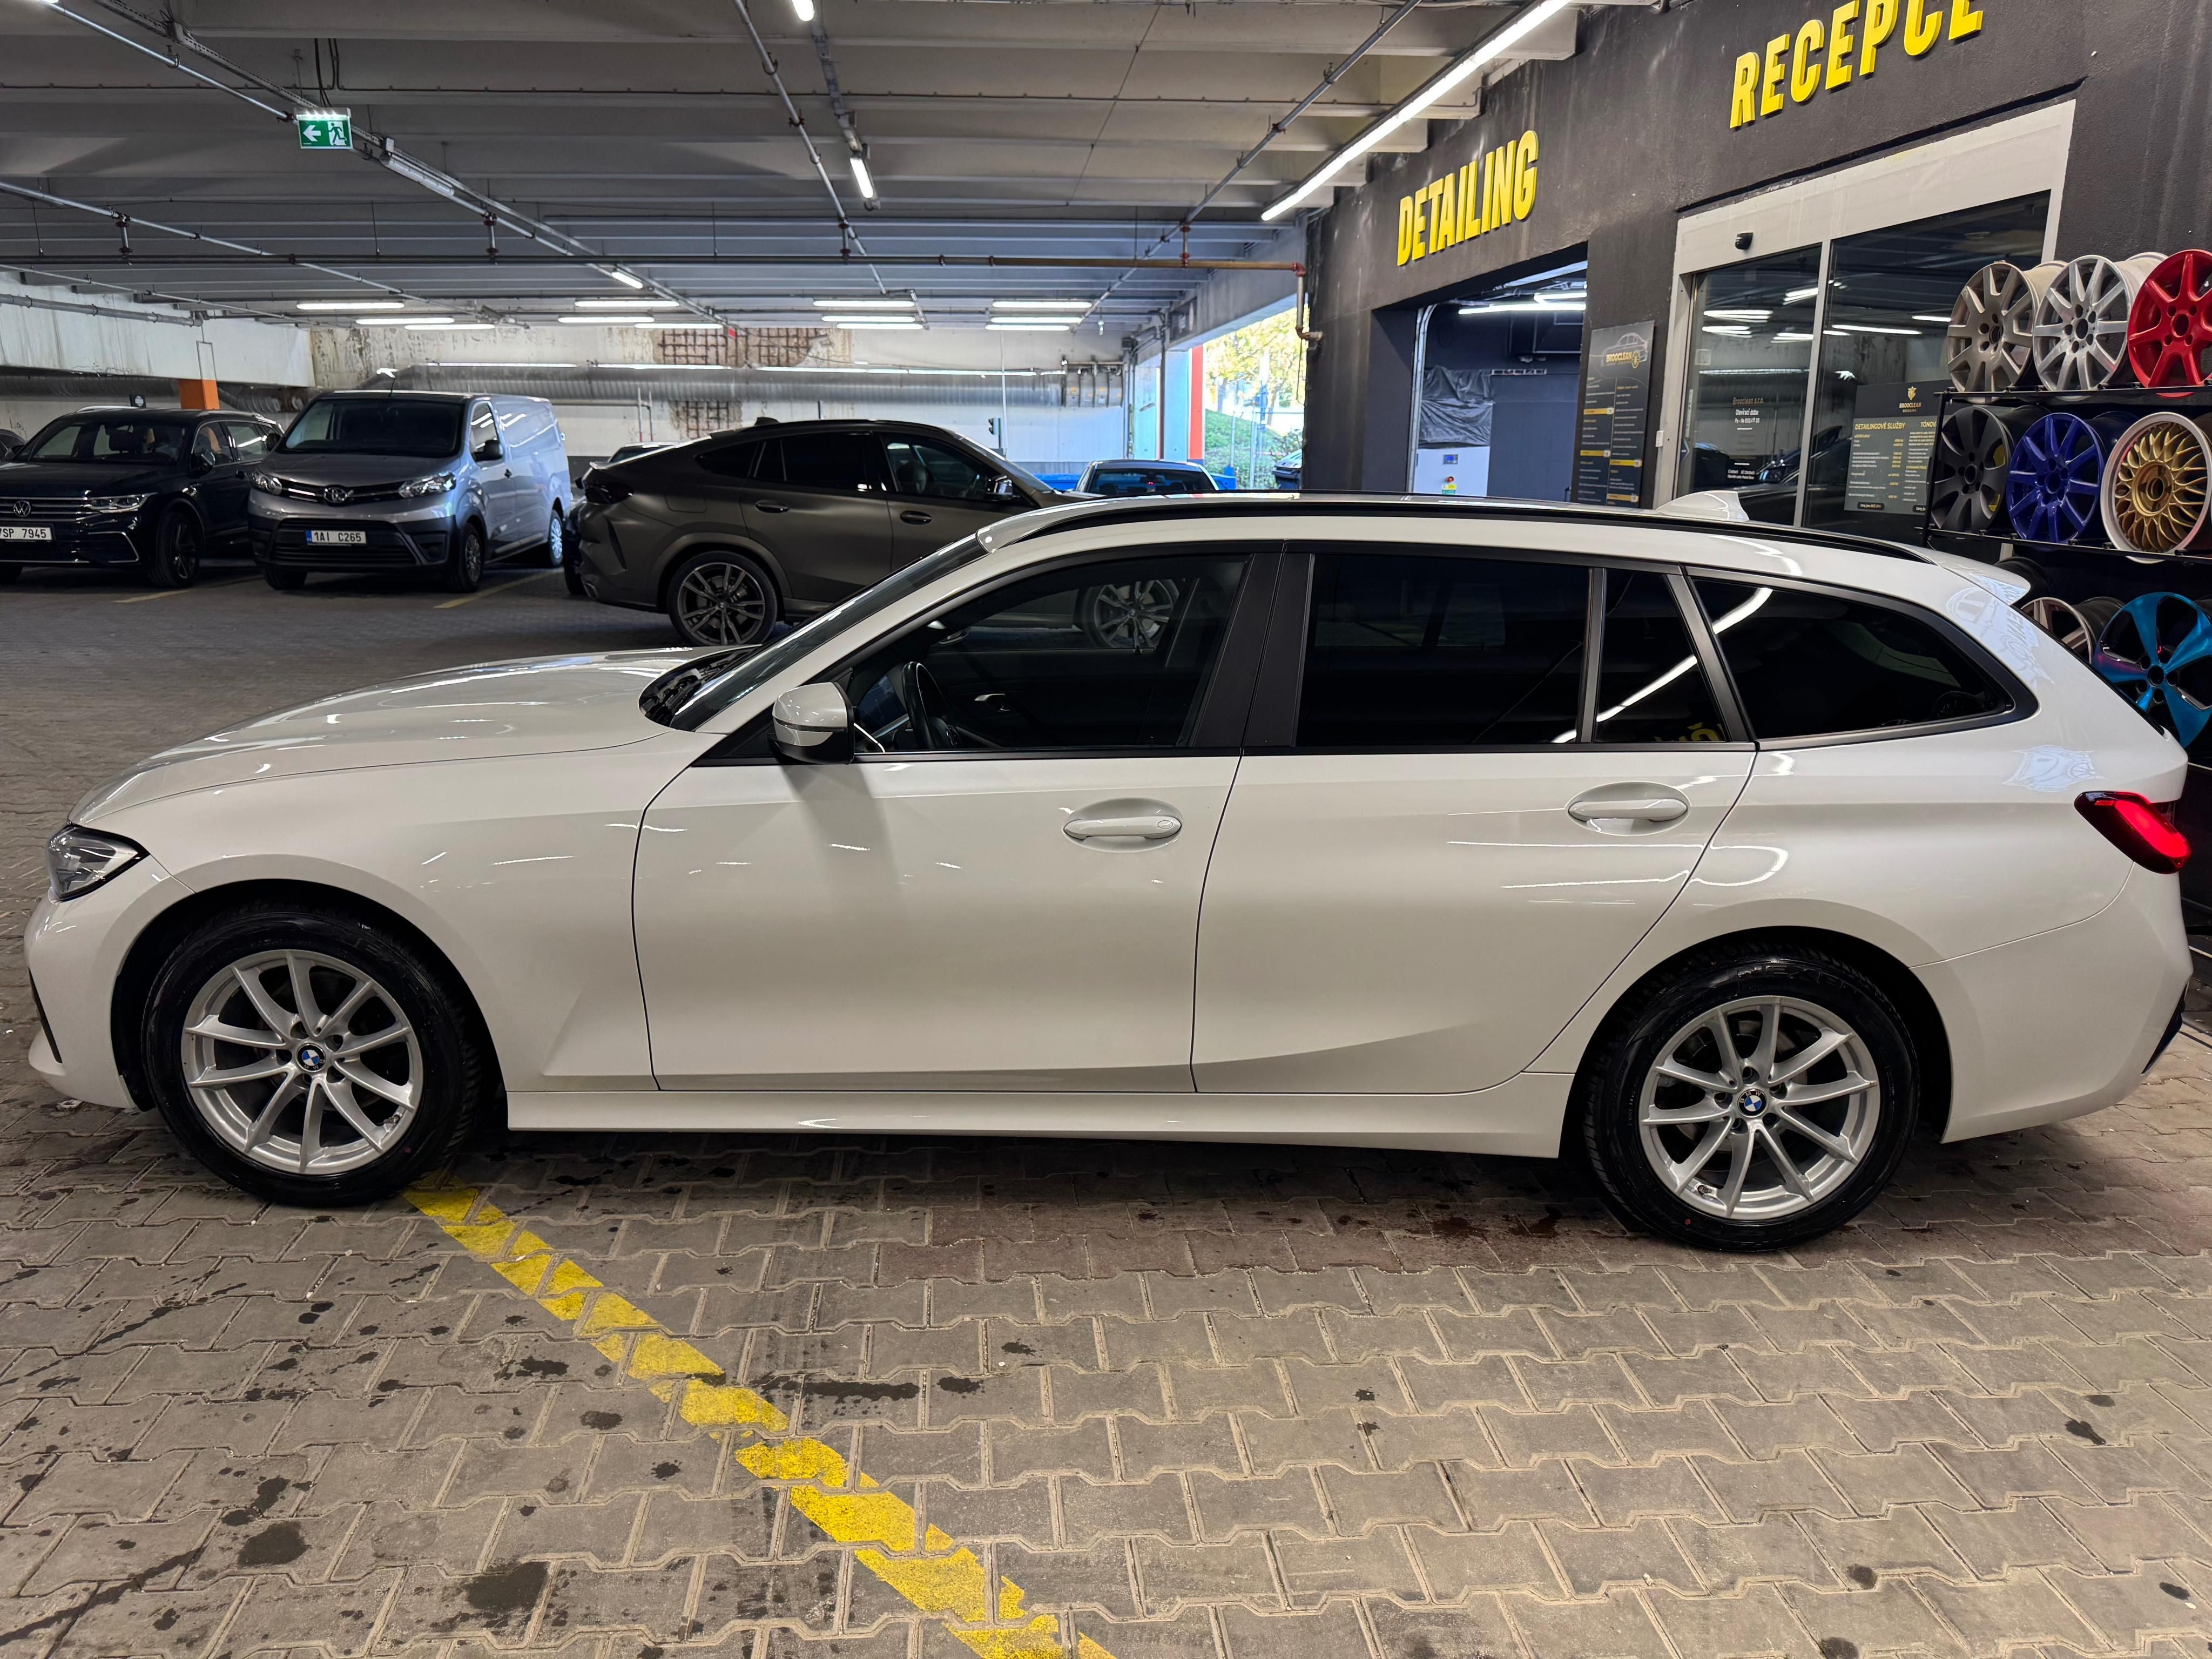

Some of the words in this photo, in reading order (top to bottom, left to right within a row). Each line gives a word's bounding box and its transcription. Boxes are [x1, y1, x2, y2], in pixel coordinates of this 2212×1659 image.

[1397, 130, 1539, 266] DETAILING
[1854, 421, 1887, 430] DETAILINGOVÉ
[1887, 421, 1906, 429] SLUŽBY
[22, 529, 46, 538] 7945
[314, 531, 329, 542] 1AI
[338, 532, 361, 542] C265
